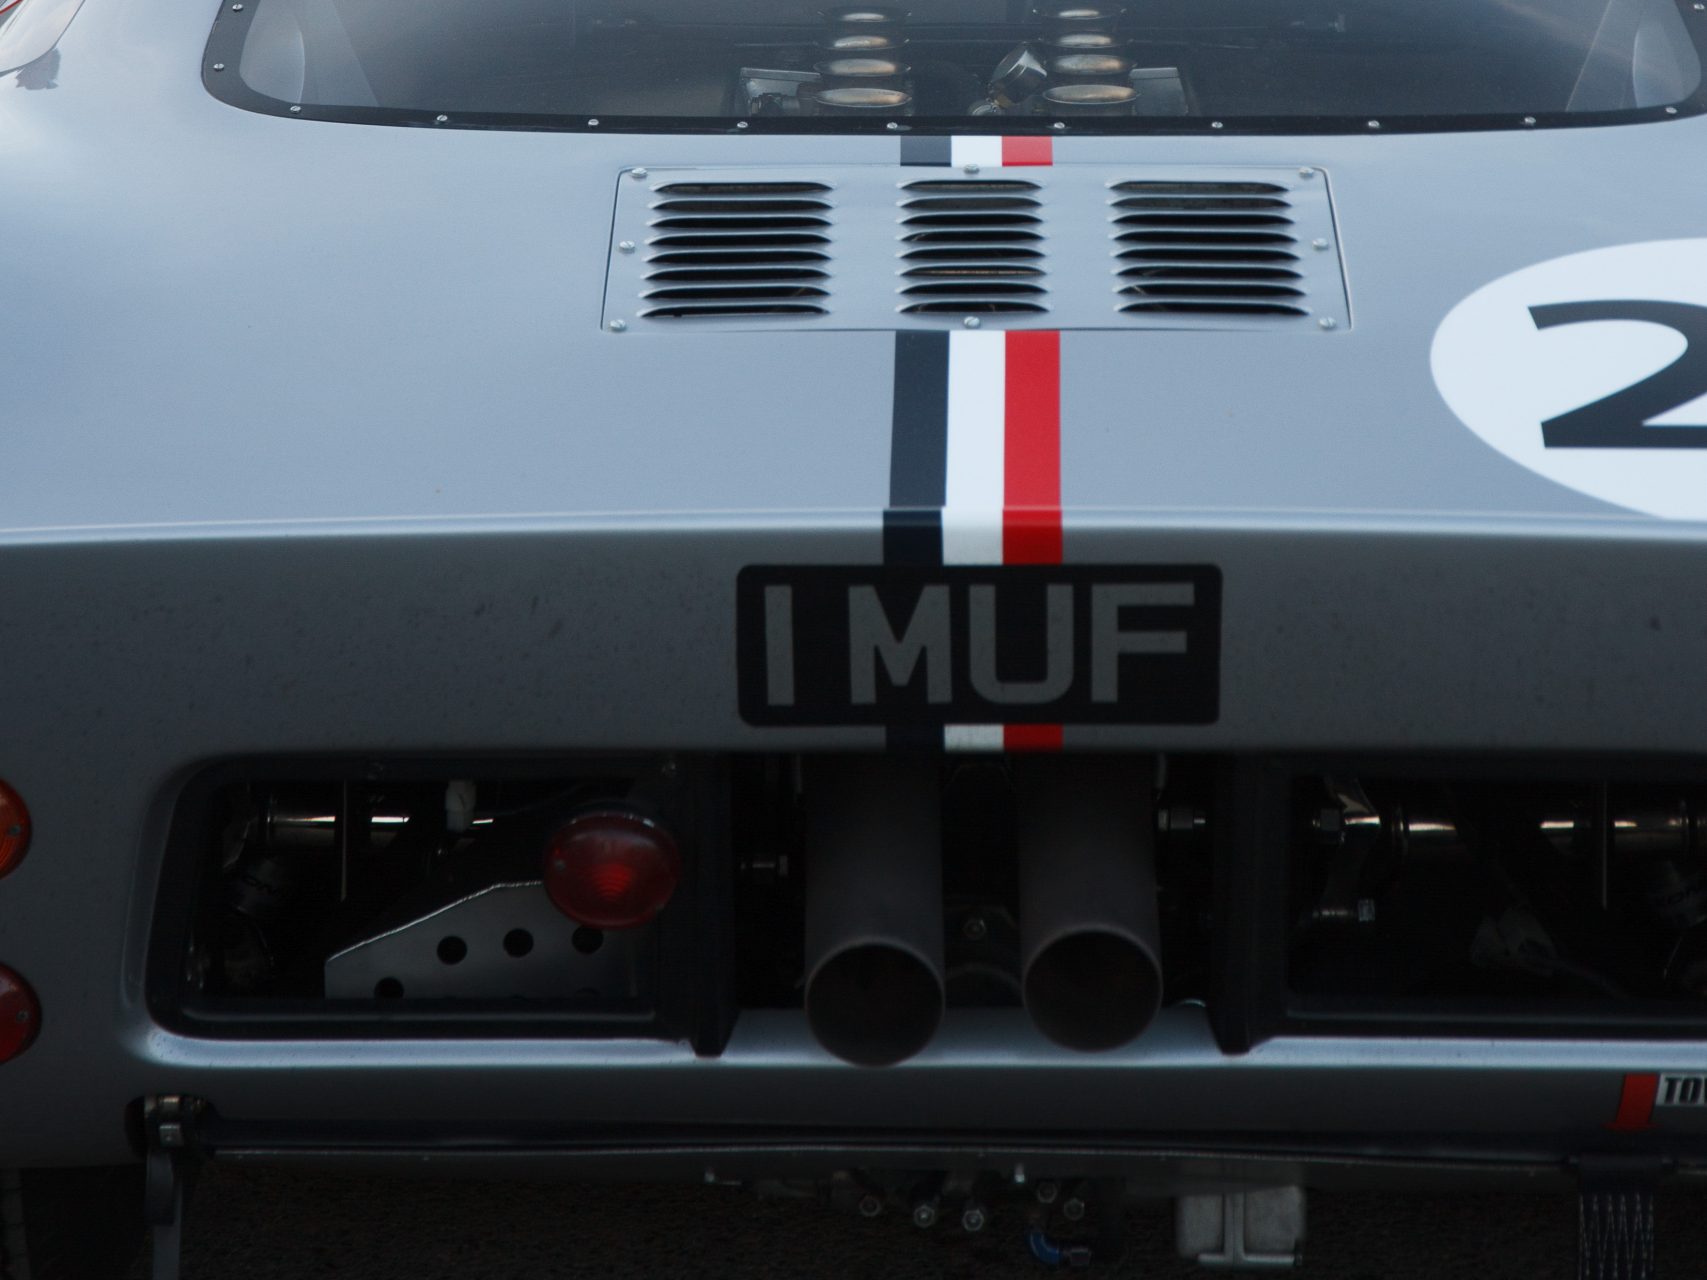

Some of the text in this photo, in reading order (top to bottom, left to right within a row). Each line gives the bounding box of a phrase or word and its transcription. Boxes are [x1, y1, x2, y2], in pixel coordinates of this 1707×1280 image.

[1528, 299, 1707, 449] 2
[848, 583, 1195, 704] MUF
[1664, 1076, 1707, 1104] TO
